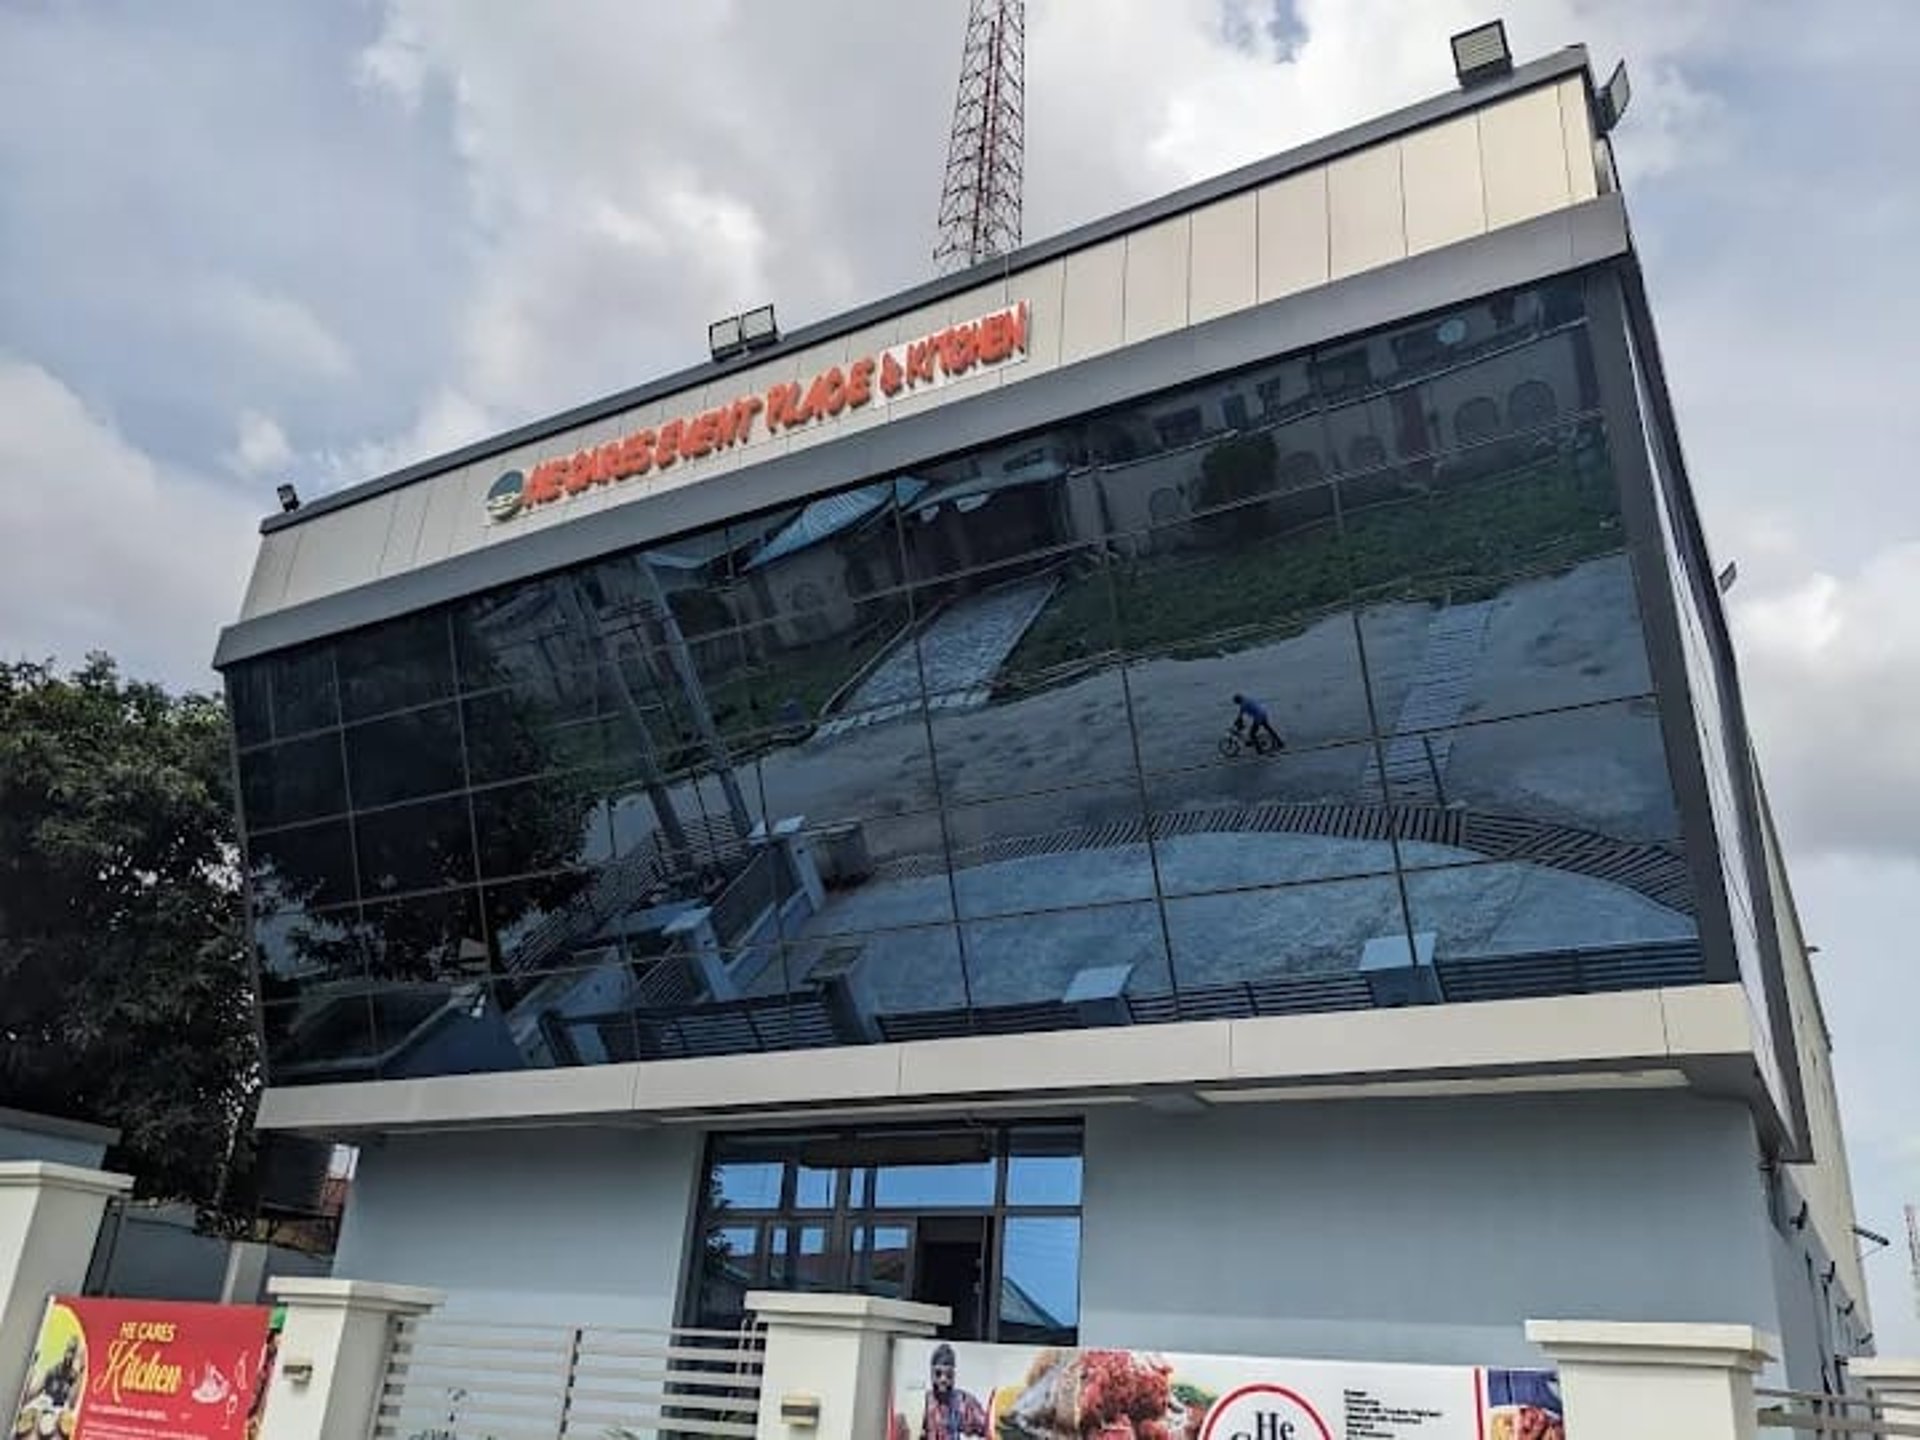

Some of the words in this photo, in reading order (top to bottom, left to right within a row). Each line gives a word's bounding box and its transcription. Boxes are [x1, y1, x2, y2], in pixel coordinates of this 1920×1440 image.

[567, 429, 656, 495] CARES
[656, 397, 763, 469] EVENT
[766, 357, 875, 434] PLACE
[880, 351, 903, 398] &
[906, 301, 1026, 388] KITCHEN
[121, 1322, 137, 1339] HE
[138, 1322, 177, 1341] CARES
[93, 1340, 182, 1403] Kitchen
[1256, 1411, 1294, 1440] He
